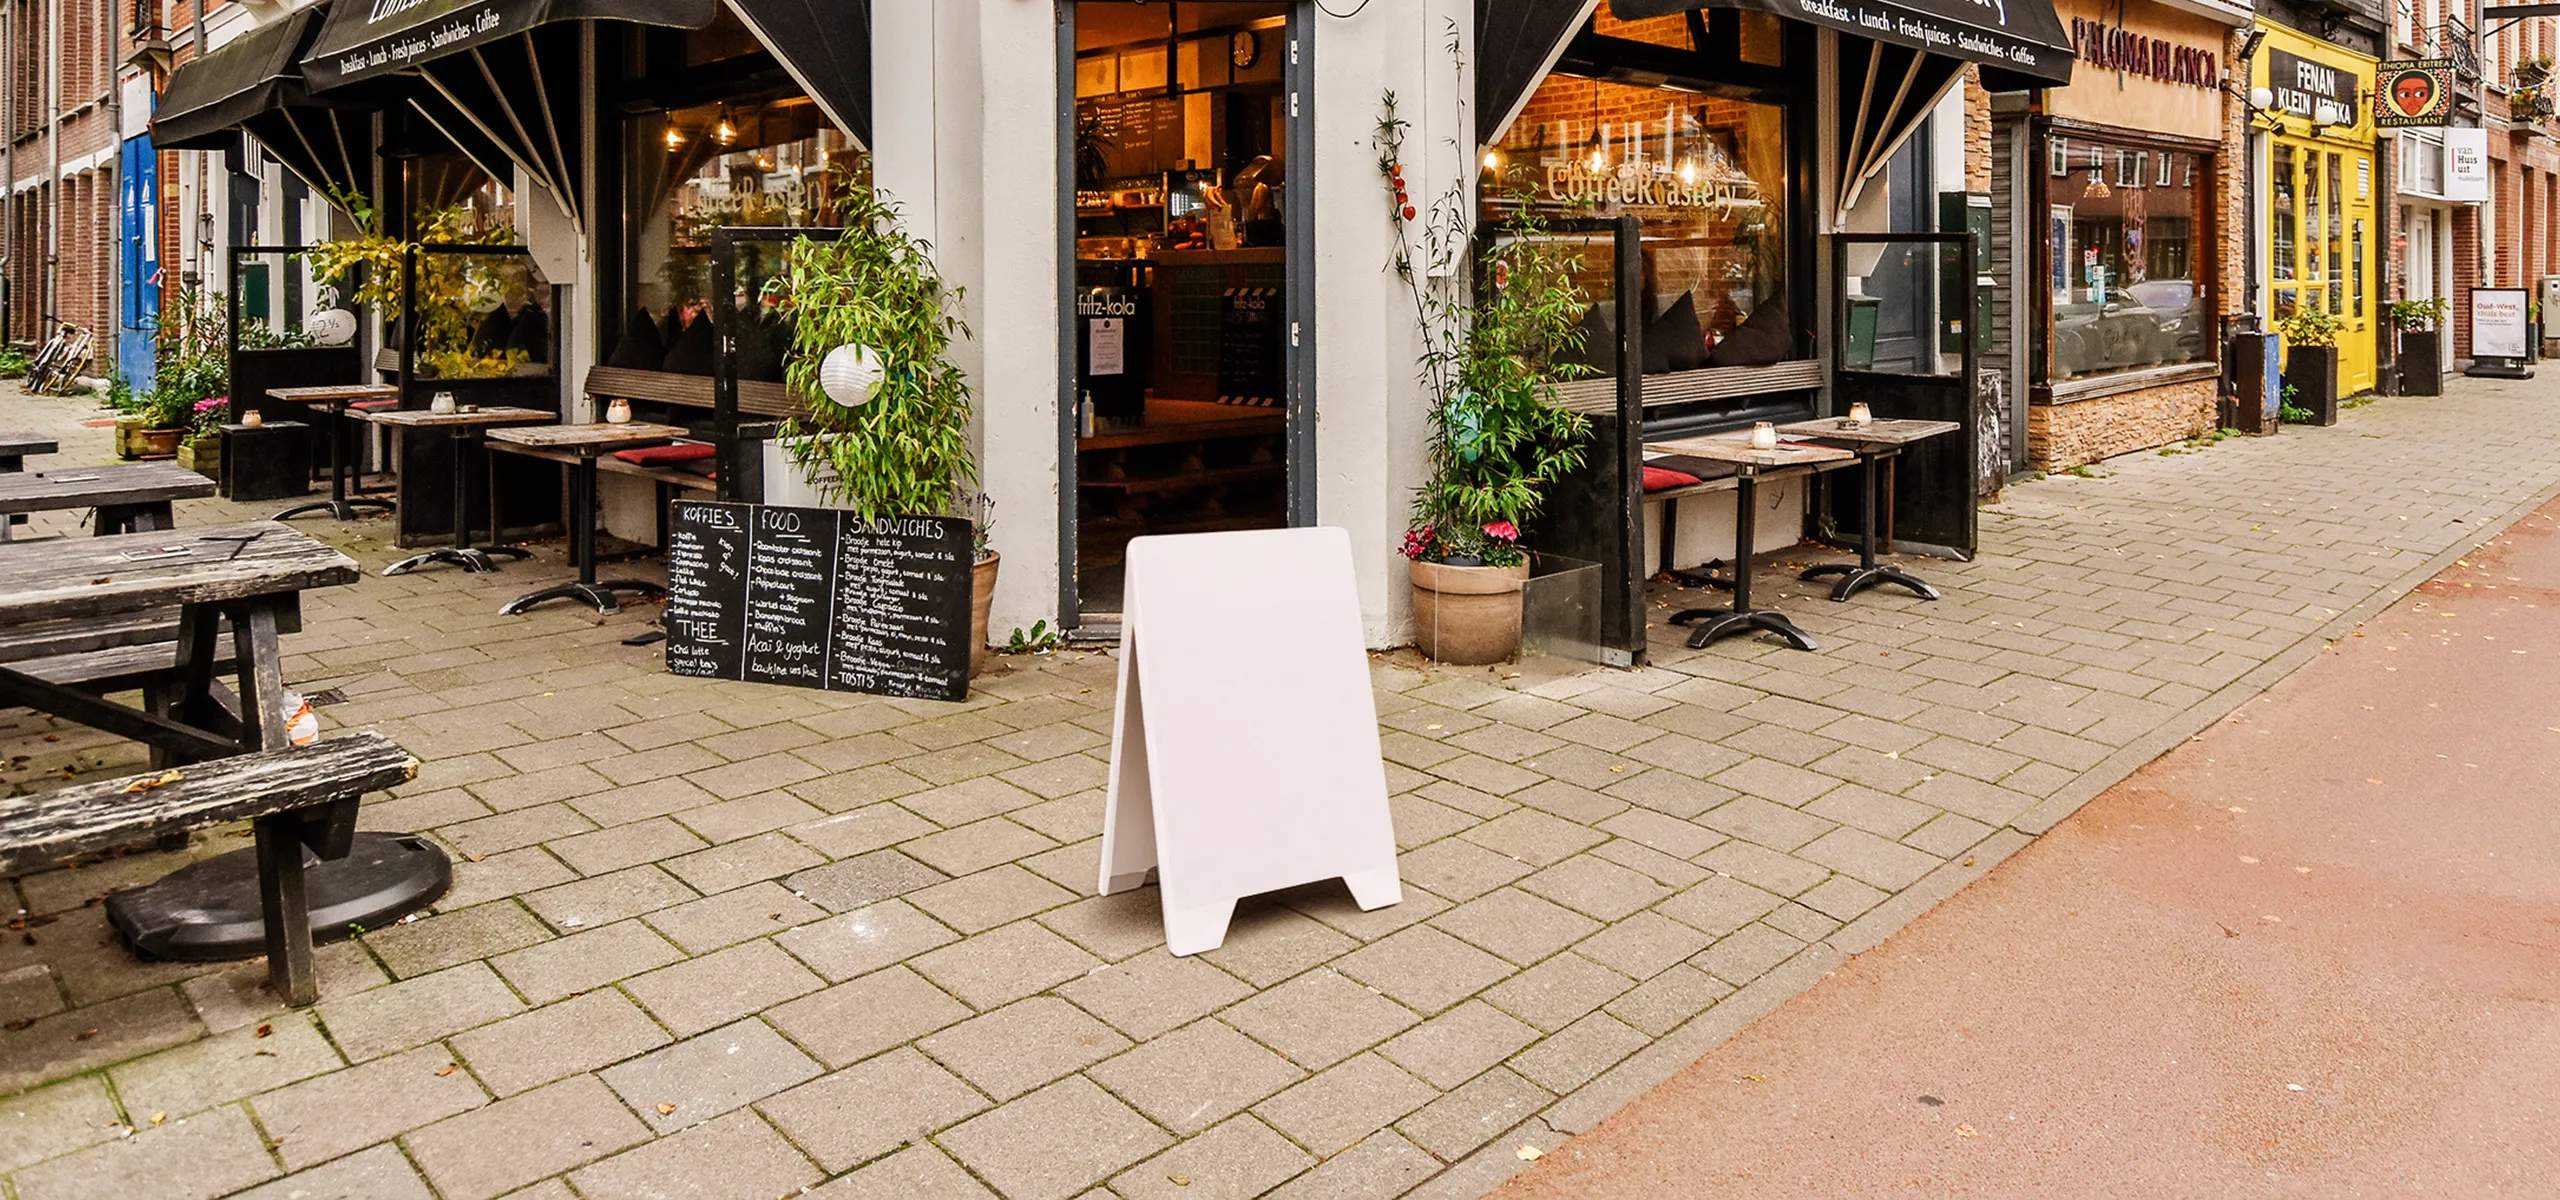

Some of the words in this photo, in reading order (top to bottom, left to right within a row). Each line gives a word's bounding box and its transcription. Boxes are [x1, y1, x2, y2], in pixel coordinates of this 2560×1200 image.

[340, 53, 366, 75] Breakfast
[369, 45, 387, 66] Lunch
[430, 20, 470, 49] Sandwiches
[475, 8, 500, 33] Coffee
[1800, 0, 1850, 22] Breakfast
[1859, 8, 1890, 31] Lunch
[1899, 17, 1924, 40] Fresh
[1925, 24, 1951, 47] juices
[1958, 31, 2004, 58] Sandwiches
[2010, 45, 2036, 66] Coffee
[2072, 16, 2150, 76] PALOMA
[2152, 39, 2217, 89] BLANCA
[2378, 62, 2415, 71] ETHIOPIA
[2418, 60, 2450, 69] ERITREA
[2297, 60, 2335, 97] FENAN
[2278, 86, 2311, 115] KLEIN
[2381, 116, 2443, 126] RESTAURANT
[2457, 147, 2473, 155] van
[2457, 155, 2478, 164] Huis
[1077, 293, 1135, 316] fritz-kola
[762, 509, 800, 532] FOOD
[676, 619, 718, 640] THEE
